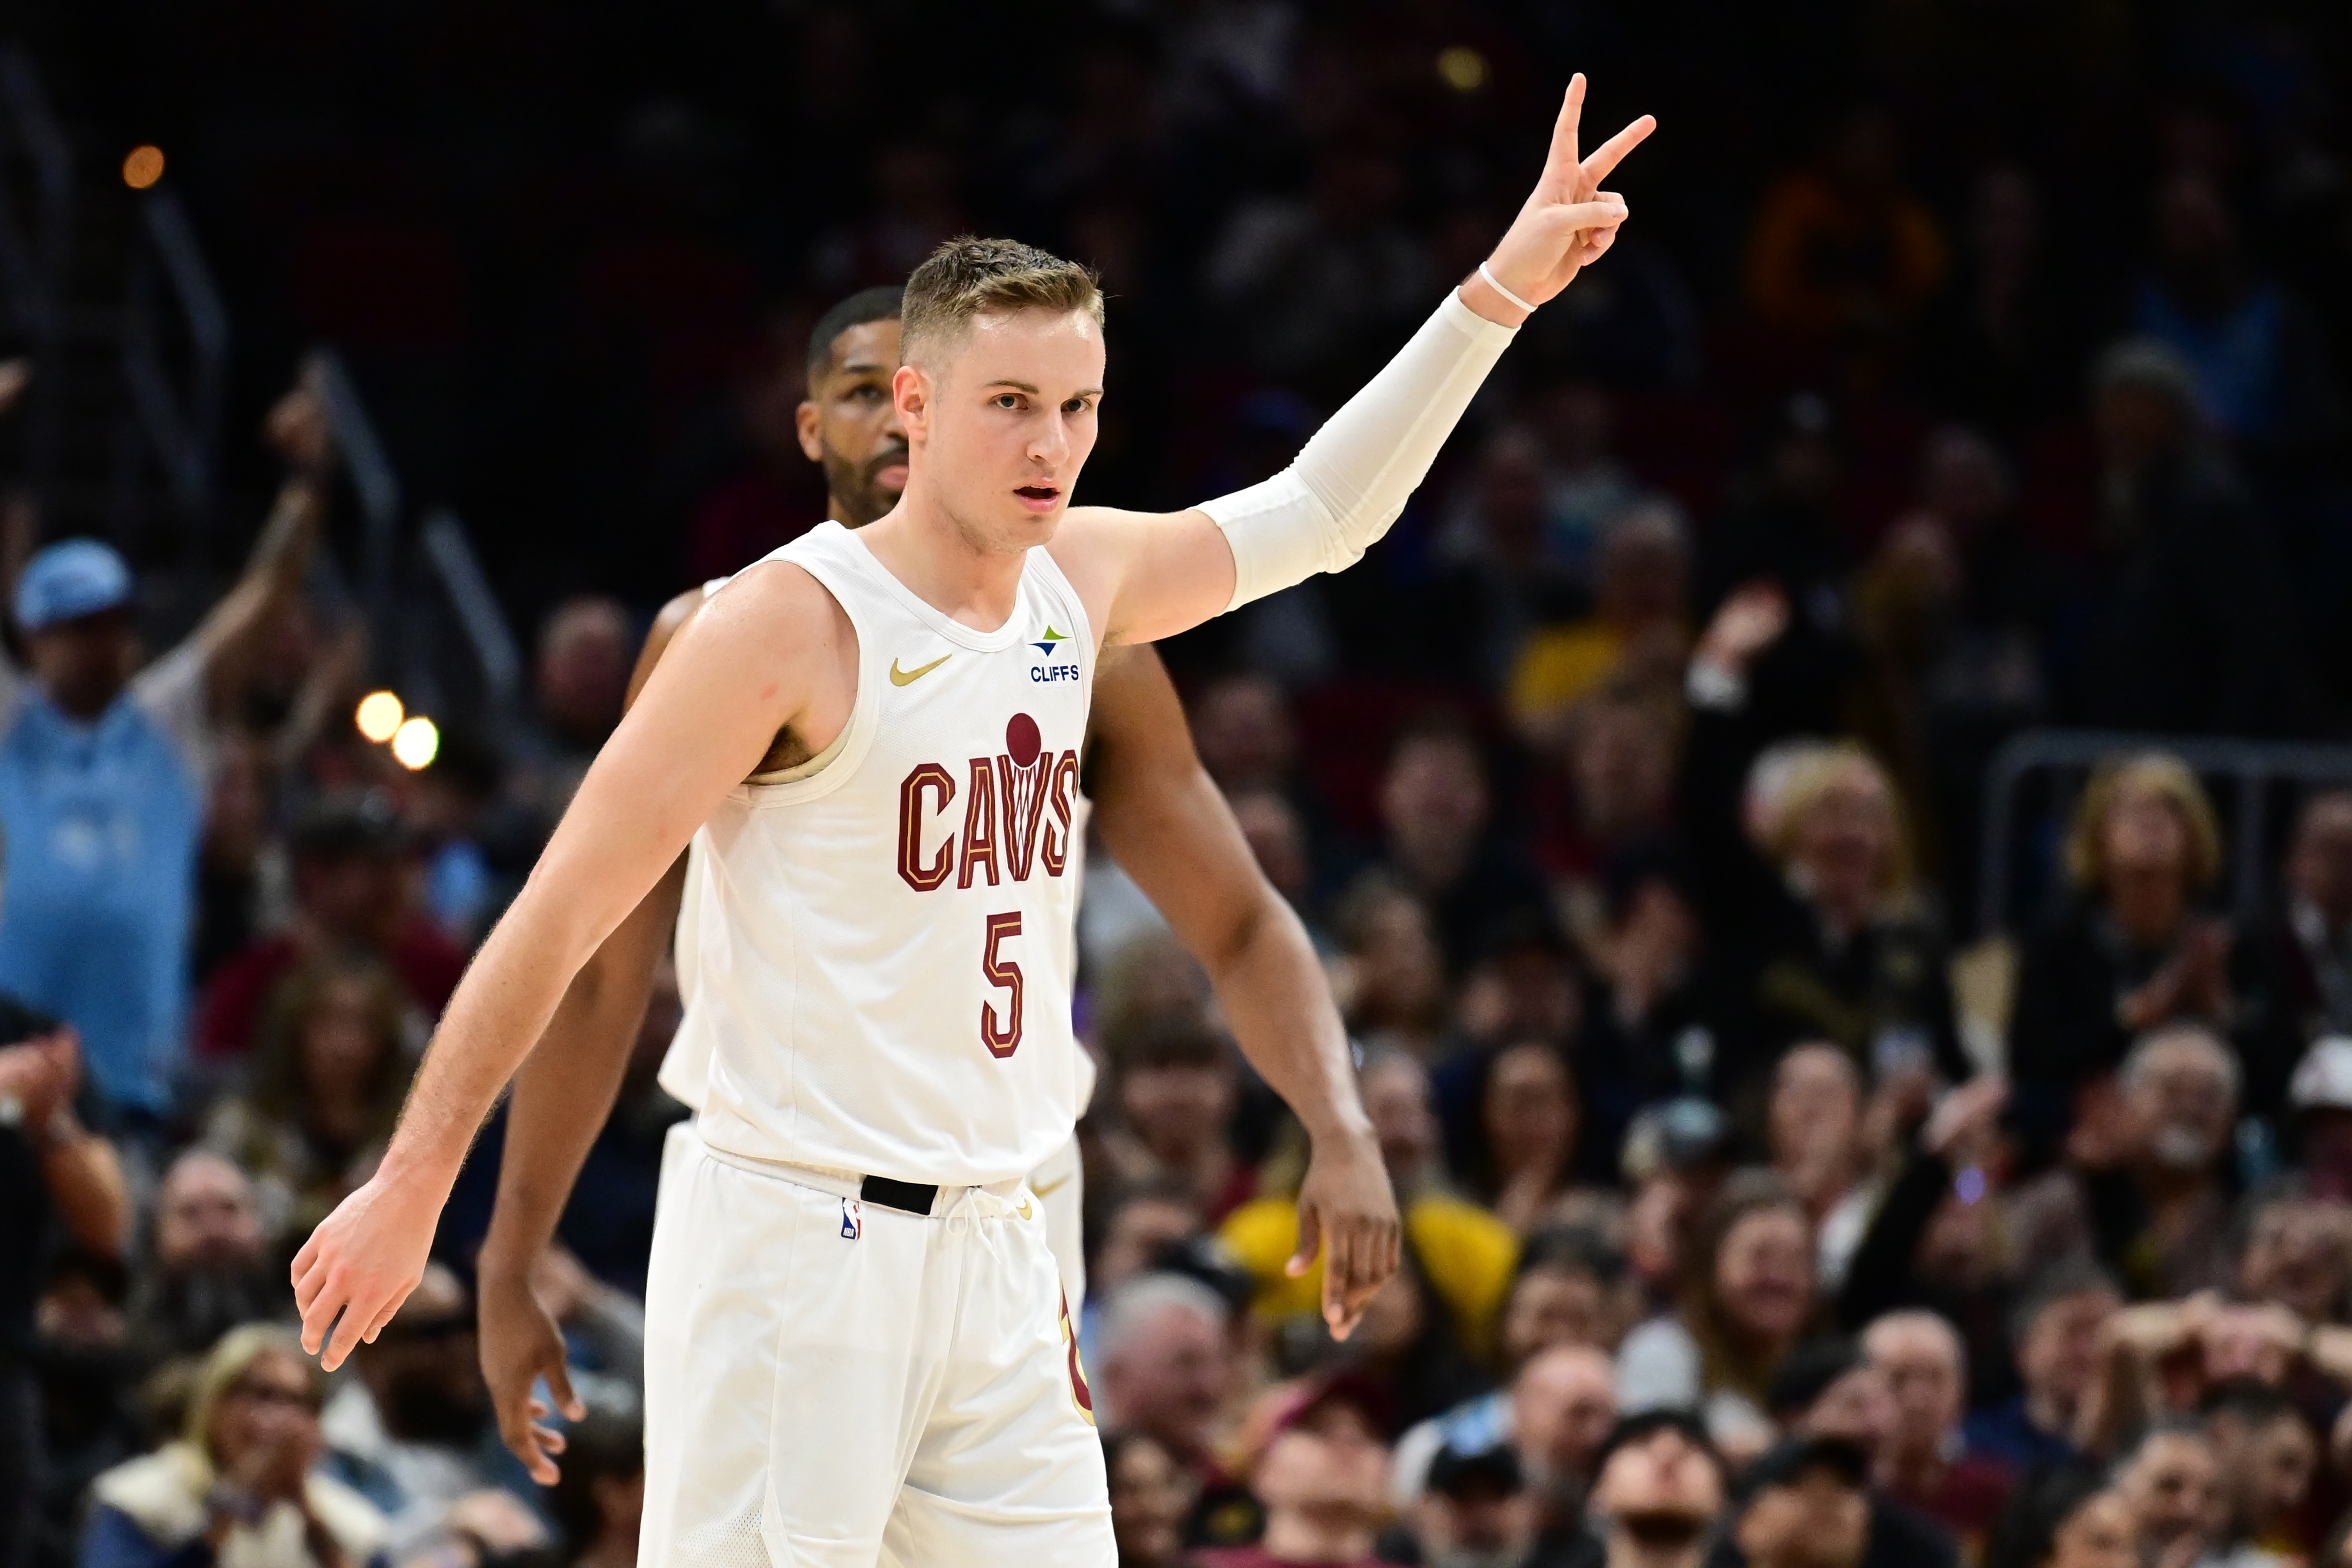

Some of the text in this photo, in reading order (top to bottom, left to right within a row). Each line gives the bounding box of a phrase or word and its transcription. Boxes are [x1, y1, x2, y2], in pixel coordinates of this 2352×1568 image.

[1031, 665, 1079, 682] CLIFFS
[897, 749, 1079, 891] CAVS
[981, 911, 1022, 1058] 5
[843, 1227, 854, 1237] NBA
